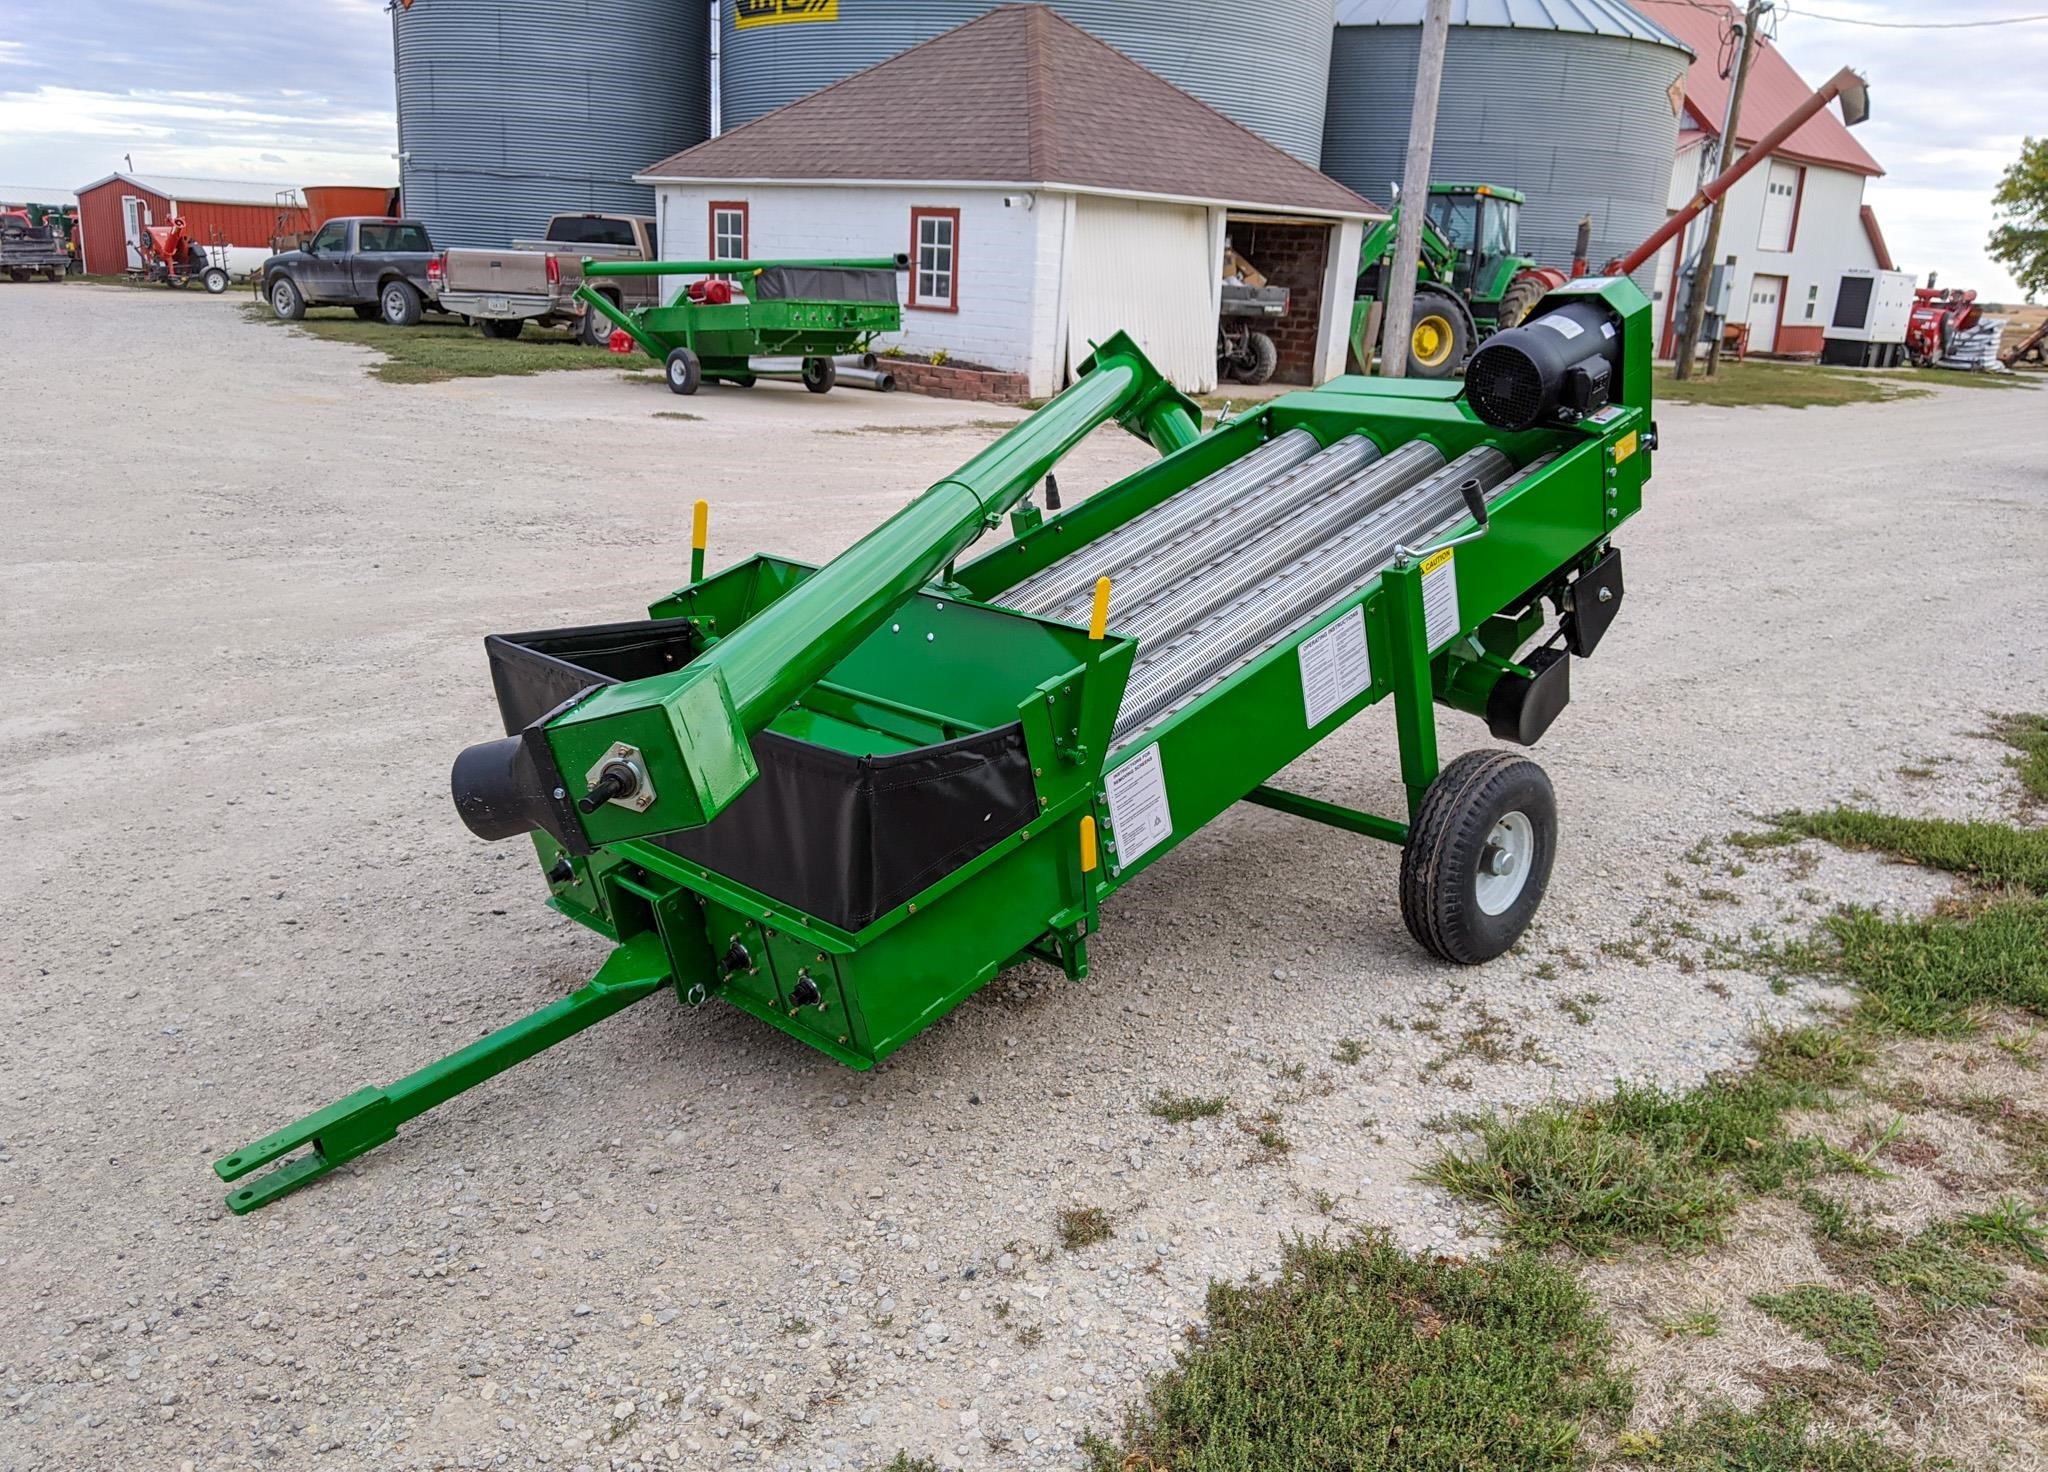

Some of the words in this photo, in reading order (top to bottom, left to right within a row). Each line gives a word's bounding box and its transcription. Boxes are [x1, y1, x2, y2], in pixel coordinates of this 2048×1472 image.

[1425, 550, 1451, 571] CAUTION
[1303, 631, 1328, 651] OPERATING
[1328, 610, 1359, 634] INSTRUCTIONS
[1113, 757, 1142, 779] INSTRUCTIONS
